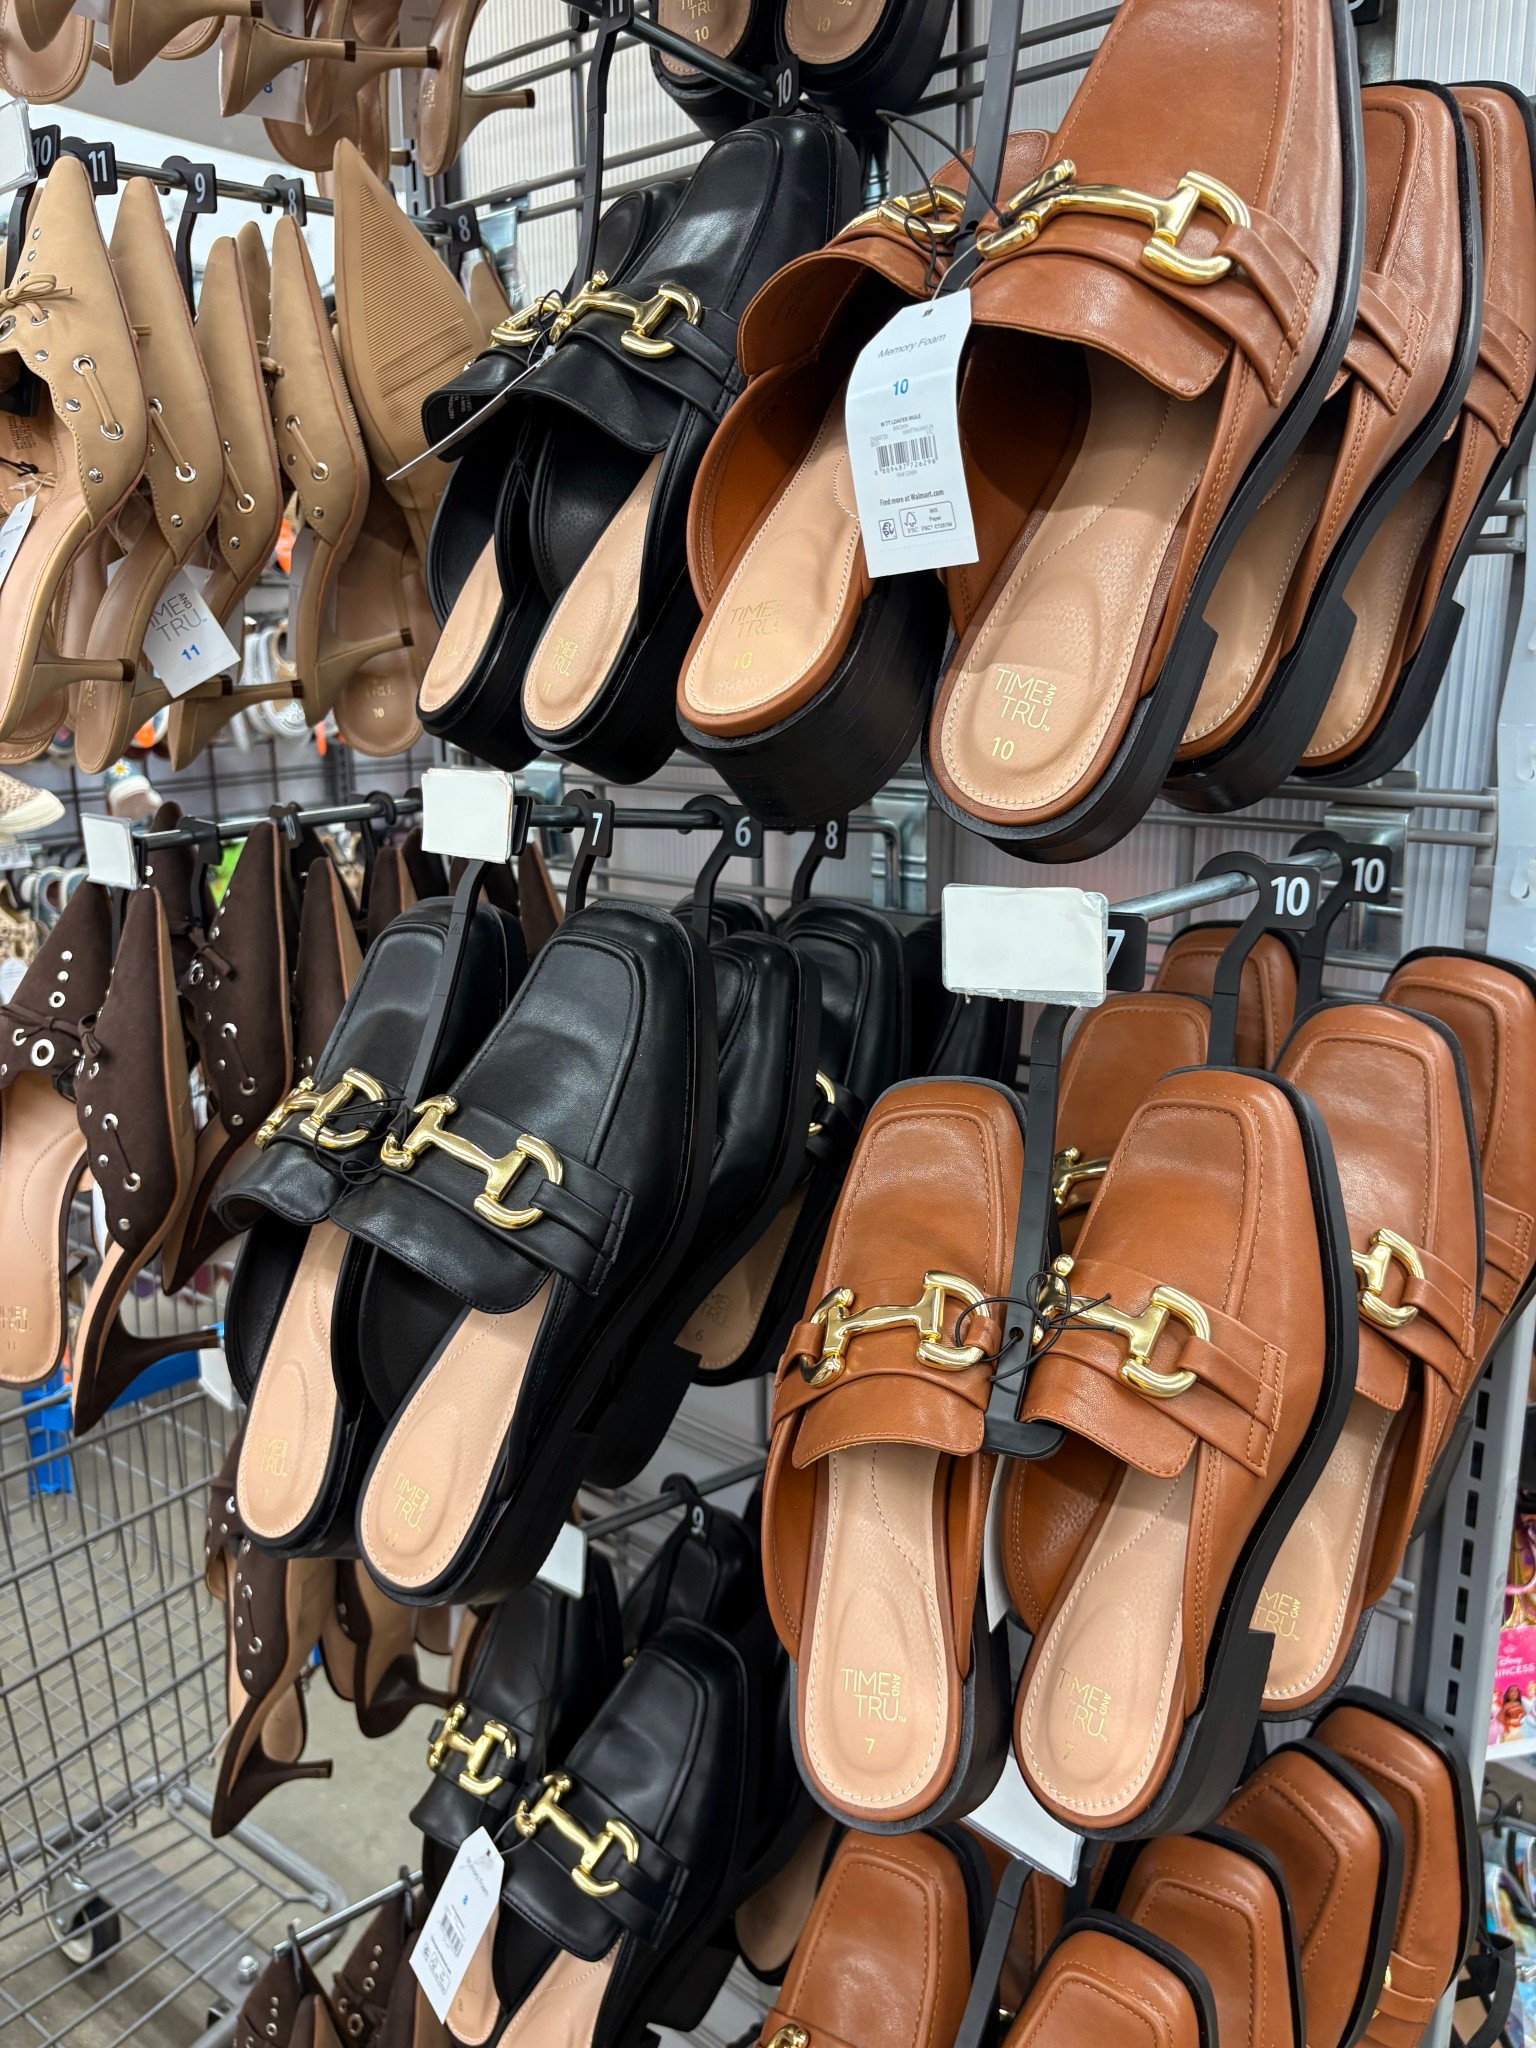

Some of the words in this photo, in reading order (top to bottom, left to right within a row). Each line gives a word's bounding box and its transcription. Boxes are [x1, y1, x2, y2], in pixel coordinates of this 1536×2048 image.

[694, 26, 710, 42] 10
[816, 17, 831, 32] 10
[775, 68, 793, 108] 10
[33, 135, 52, 167] 10
[88, 150, 108, 183] 11
[194, 172, 206, 204] 9
[287, 188, 297, 218] 8
[458, 214, 472, 242] 8
[878, 342, 917, 358] Memory
[918, 334, 946, 348] Foam
[893, 379, 909, 396] 10
[910, 489, 945, 501] Walmart.com
[149, 596, 185, 629] IME
[178, 592, 193, 610] AND
[731, 600, 775, 625] TIME
[181, 644, 201, 661] 11
[733, 651, 752, 671] 10
[995, 668, 1049, 704] TIME
[1043, 683, 1057, 706] AND
[991, 736, 1015, 761] 10
[592, 812, 603, 847] 7
[735, 816, 751, 847] 6
[825, 820, 838, 850] 8
[1351, 857, 1386, 894] 10
[1270, 876, 1310, 917] 10
[1106, 929, 1126, 976] 7
[393, 1472, 426, 1508] TIME
[690, 1505, 705, 1534] 9
[1257, 1586, 1293, 1616] ME
[1290, 1598, 1301, 1619] AND
[840, 1667, 892, 1697] TIME
[891, 1672, 901, 1698] AND
[1059, 1667, 1104, 1712] TIME
[1098, 1691, 1112, 1716] AND
[864, 1736, 875, 1756] 7
